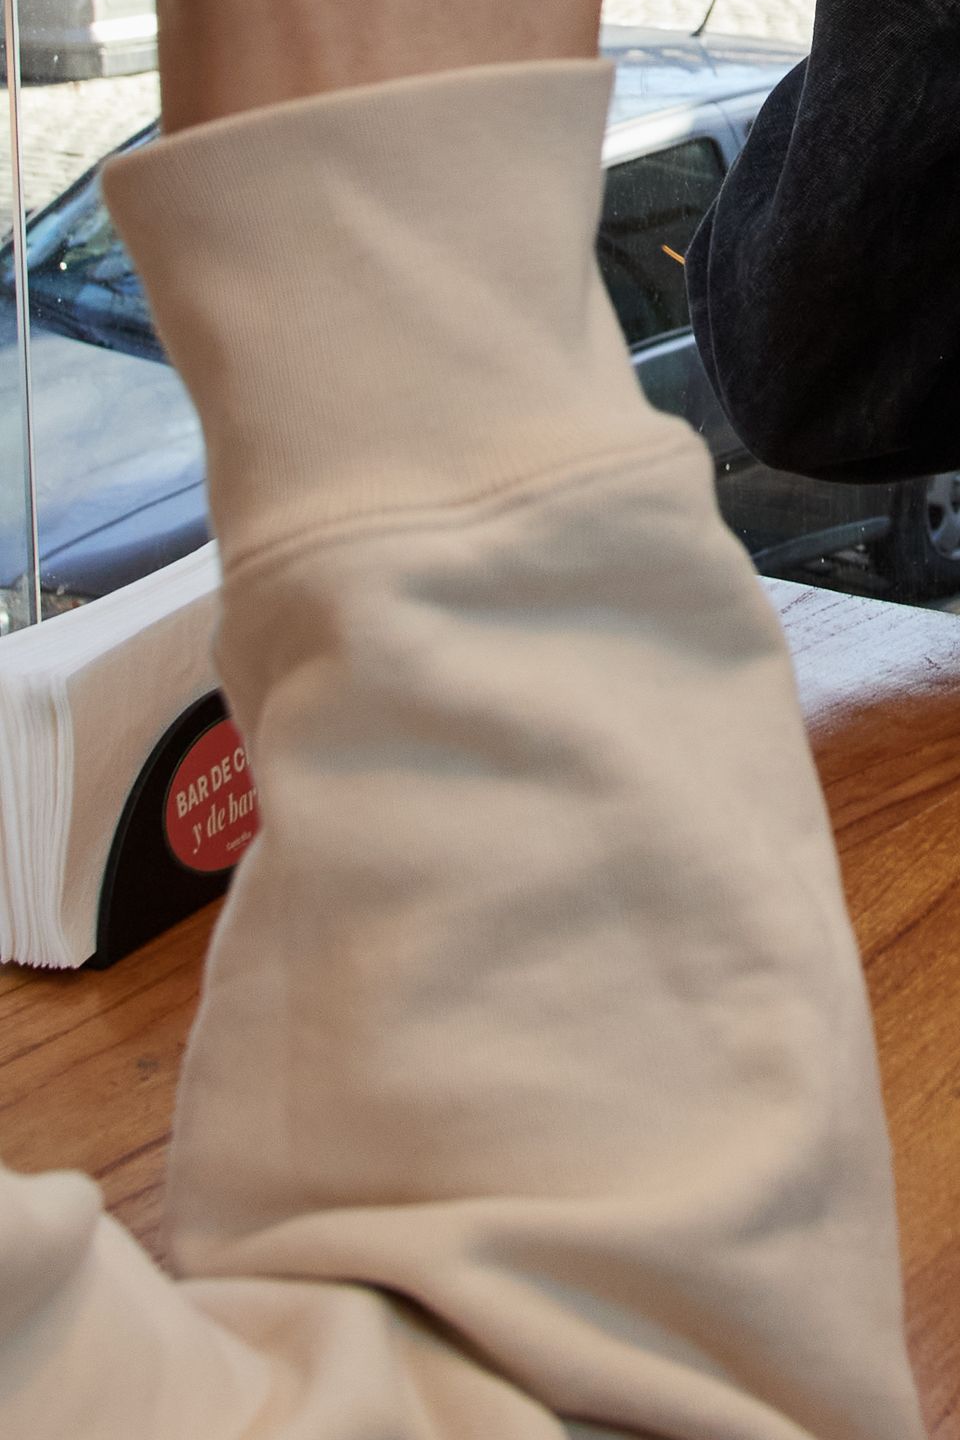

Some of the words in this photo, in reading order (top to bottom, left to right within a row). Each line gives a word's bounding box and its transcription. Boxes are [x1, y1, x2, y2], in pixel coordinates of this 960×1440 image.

[176, 774, 209, 818] BAR
[210, 757, 232, 792] DE
[233, 747, 250, 773] C
[192, 822, 202, 855] y
[207, 803, 226, 838] de
[228, 788, 258, 825] bar
